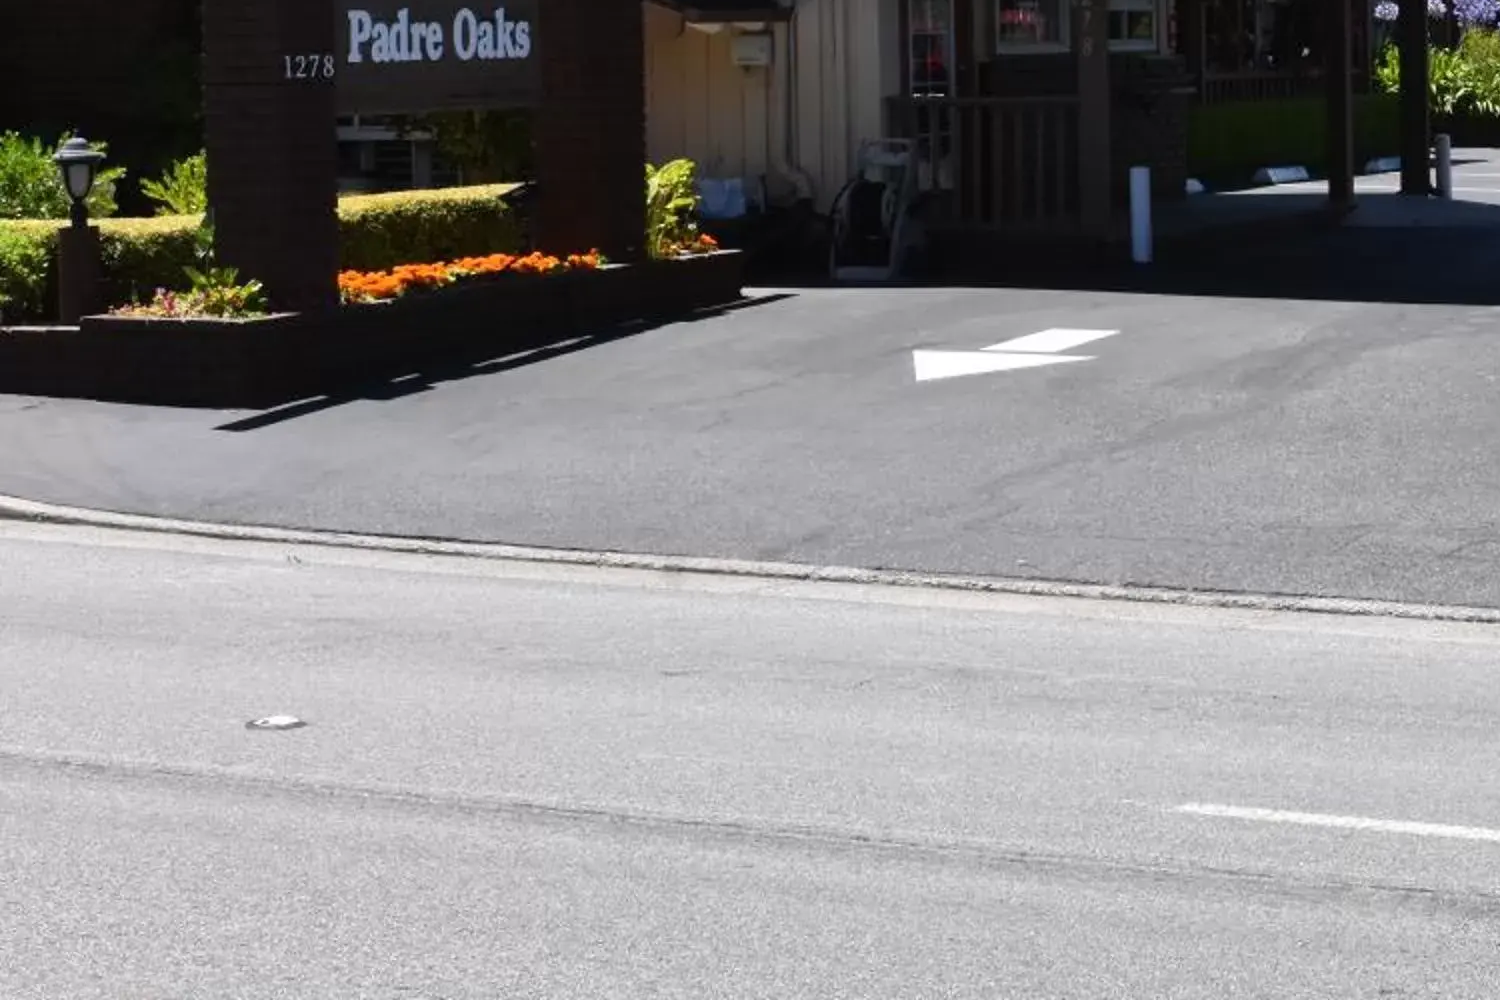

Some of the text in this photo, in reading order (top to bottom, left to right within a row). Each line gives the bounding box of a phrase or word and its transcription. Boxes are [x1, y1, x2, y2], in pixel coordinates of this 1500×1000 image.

[347, 7, 530, 62] Padre Oaks
[284, 55, 335, 78] 1278
